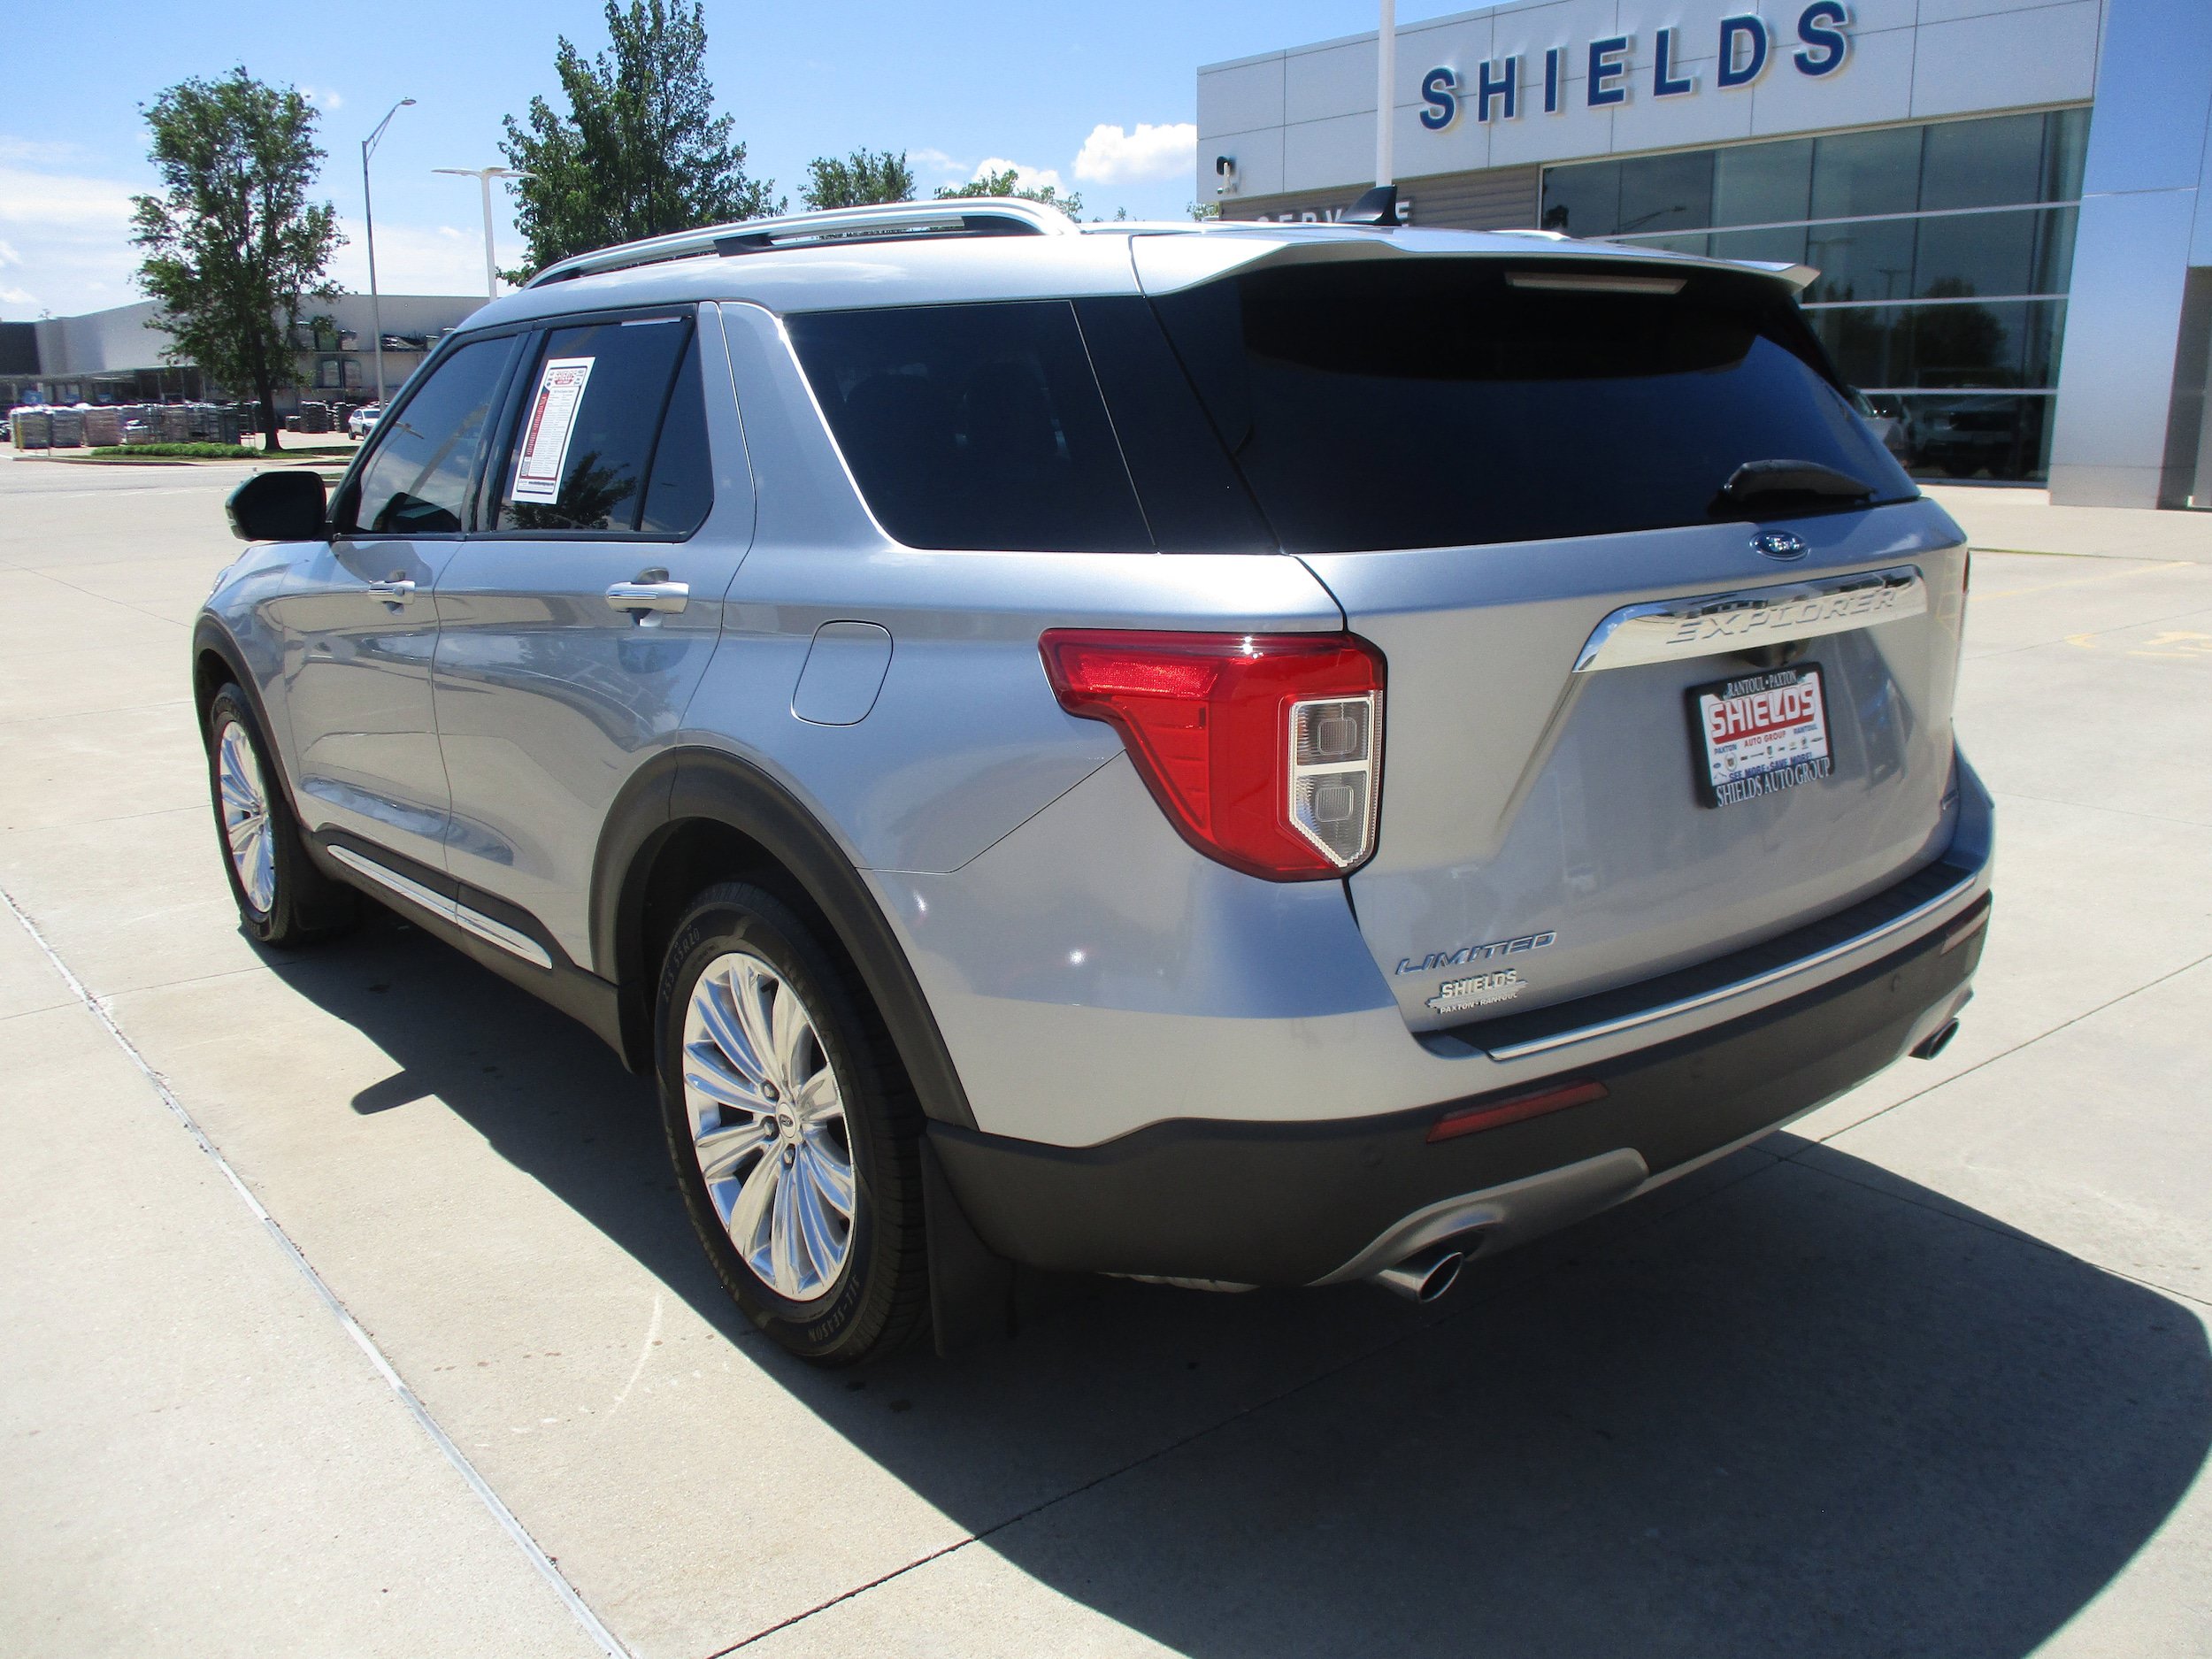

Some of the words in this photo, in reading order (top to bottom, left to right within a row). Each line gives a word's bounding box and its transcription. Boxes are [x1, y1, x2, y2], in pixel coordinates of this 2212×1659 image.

[1418, 0, 1855, 131] SHIELDS
[1665, 588, 1897, 645] EXPLORER
[1727, 676, 1766, 697] RANTOUL
[1770, 670, 1798, 688] PAXTON
[1709, 683, 1816, 740] SHIELDS
[1744, 736, 1763, 748] AUTO
[1763, 730, 1786, 742] GROUP
[1717, 775, 1763, 807] SHIELDS
[1764, 767, 1794, 795] AUTO
[1795, 757, 1831, 785] GROUP
[1394, 930, 1557, 975] LIMITED
[1439, 968, 1517, 999] SHIELDS
[1439, 1001, 1475, 1015] PAXTON
[1479, 992, 1518, 1007] RANTOUL
